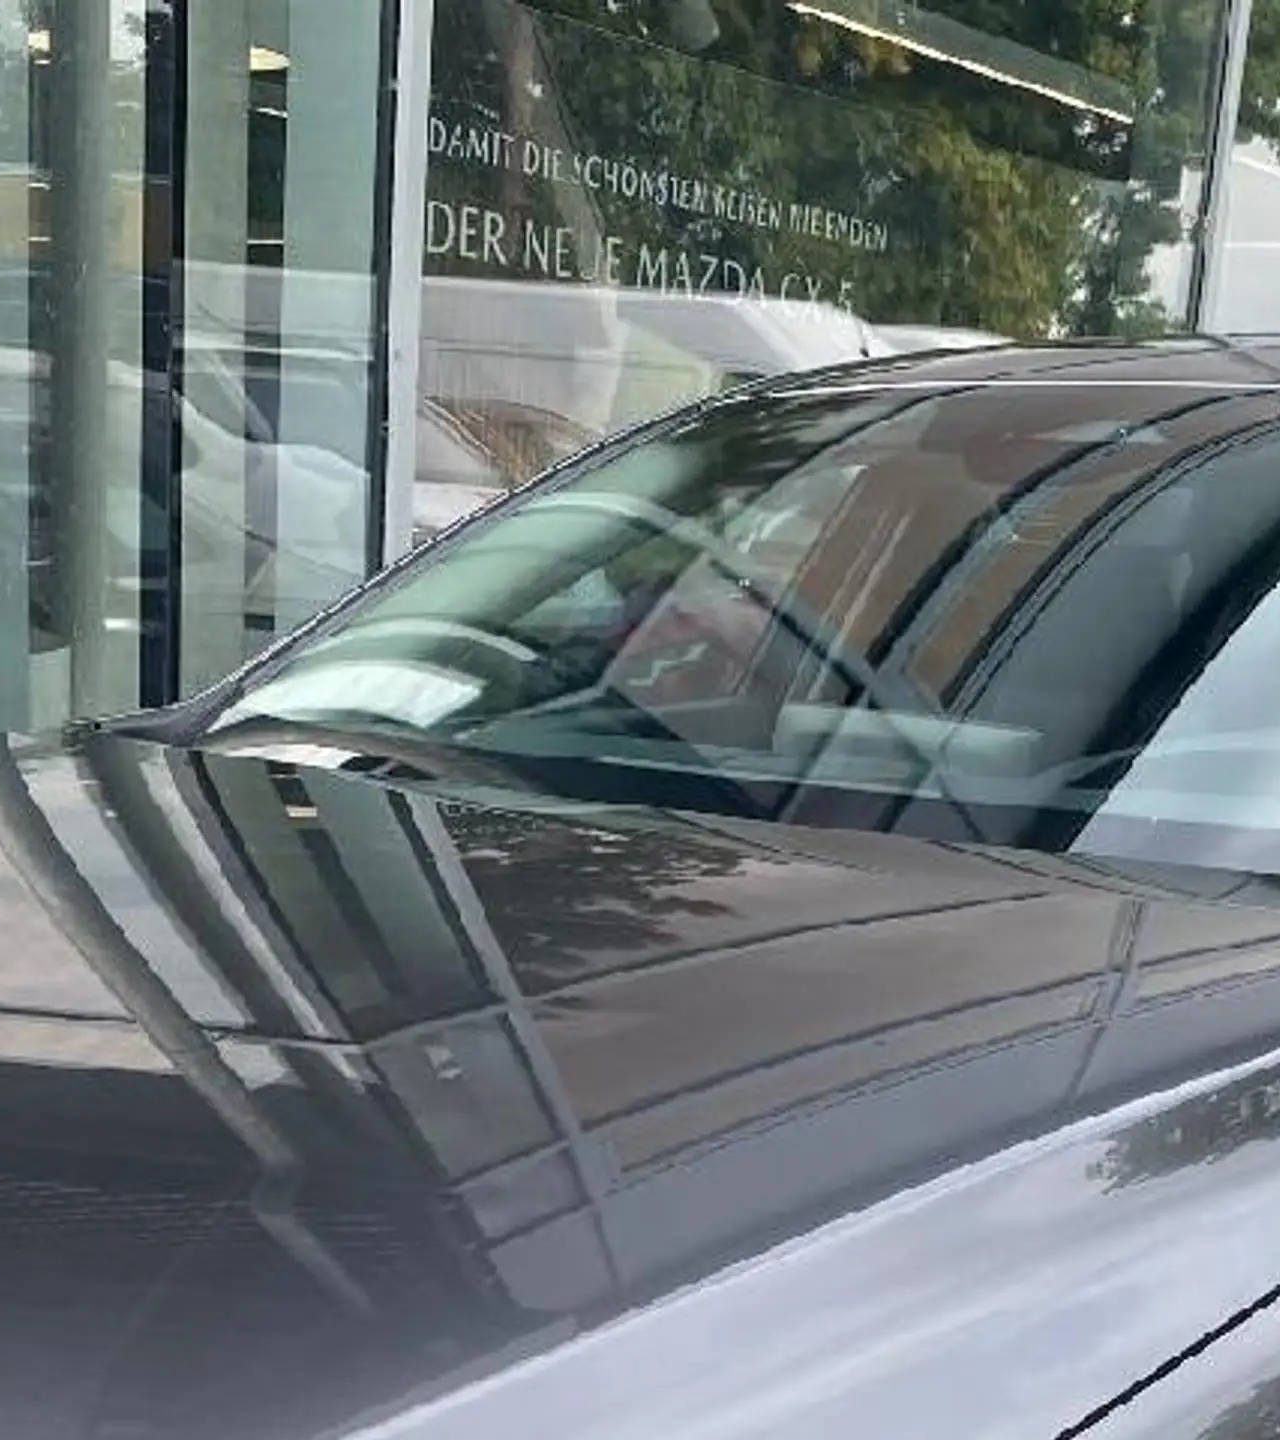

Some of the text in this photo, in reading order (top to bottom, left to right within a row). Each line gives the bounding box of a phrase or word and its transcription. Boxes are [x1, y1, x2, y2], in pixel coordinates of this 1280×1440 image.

[428, 116, 515, 169] DAMIT
[523, 139, 566, 183] DIE
[426, 199, 856, 324] DER NEUE MAZDA CX5
